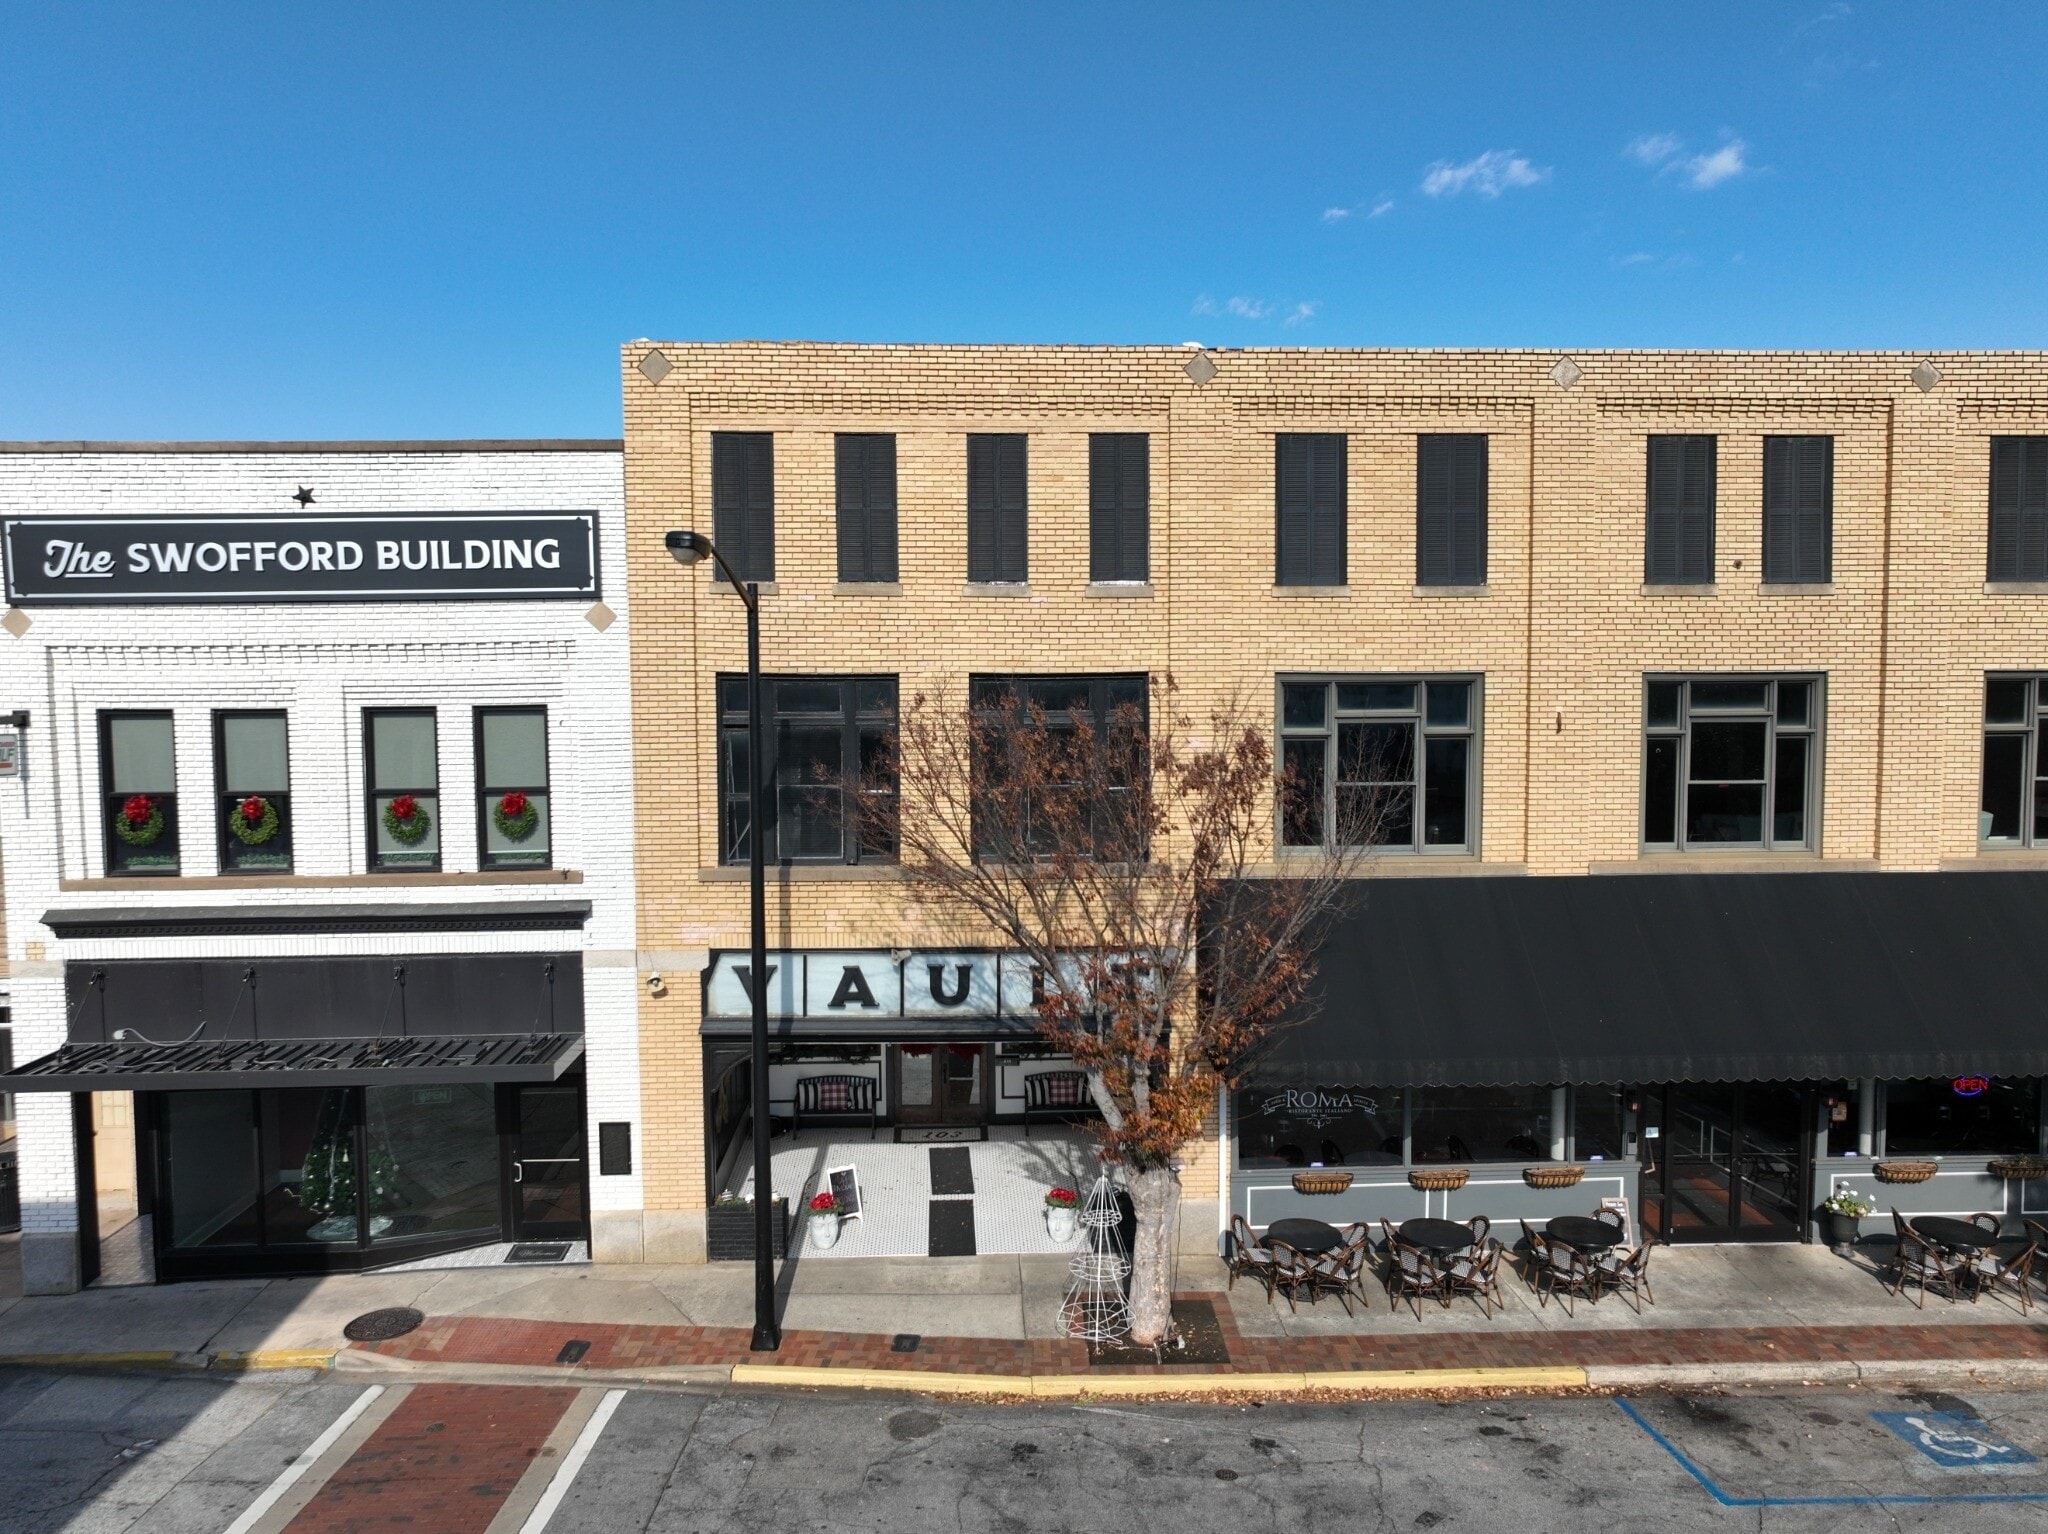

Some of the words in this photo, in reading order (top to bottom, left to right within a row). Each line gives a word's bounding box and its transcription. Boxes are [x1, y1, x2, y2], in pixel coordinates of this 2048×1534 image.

[43, 539, 116, 578] The
[127, 540, 364, 573] SWOFFORD
[376, 538, 561, 571] BUILDING
[1953, 1079, 1988, 1091] OPEN
[1286, 1089, 1354, 1108] ROMA
[923, 1131, 962, 1139] 103
